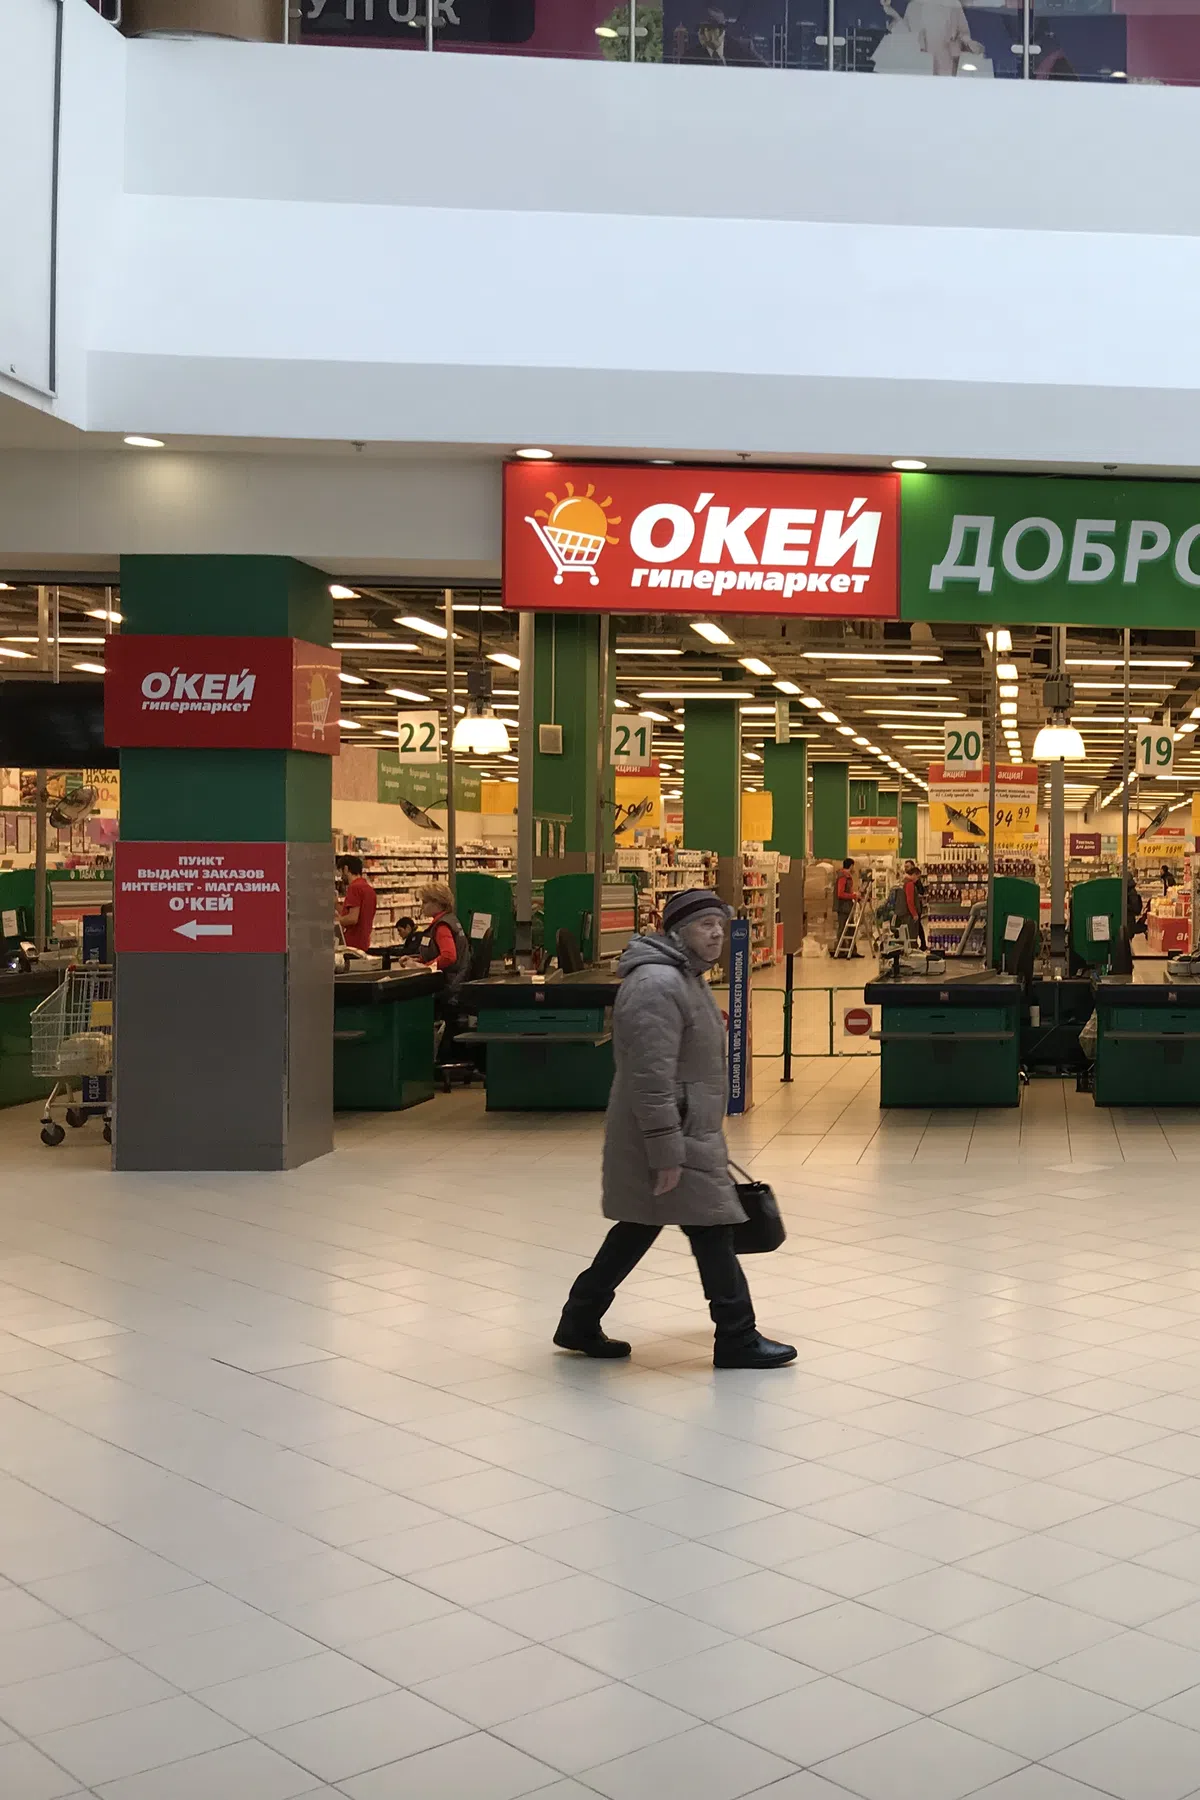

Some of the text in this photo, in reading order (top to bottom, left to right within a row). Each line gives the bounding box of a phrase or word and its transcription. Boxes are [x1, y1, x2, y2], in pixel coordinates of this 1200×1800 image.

[630, 568, 870, 598] гипермаркет
[141, 701, 251, 714] гипермаркет
[400, 722, 437, 753] 22
[614, 725, 647, 757] 21
[946, 731, 981, 761] 20
[1140, 736, 1172, 766] 19
[86, 775, 117, 784] ДАЖА
[998, 771, 1024, 780] акция!
[995, 805, 1030, 827] 94 99
[178, 856, 224, 866] ПУНКТ
[80, 868, 97, 879] ТАБАК
[138, 869, 265, 880] ВЫДАЧИ ЗАКАЗОВ
[121, 882, 194, 892] ИНТЕРНЕТ
[205, 882, 281, 892] МАГАЗИНА
[169, 893, 234, 911] О'КЕЙ
[732, 951, 744, 1098] СДЕЛАНО НА 100% ИЗ СВЕЖЕГО МОЛОКА
